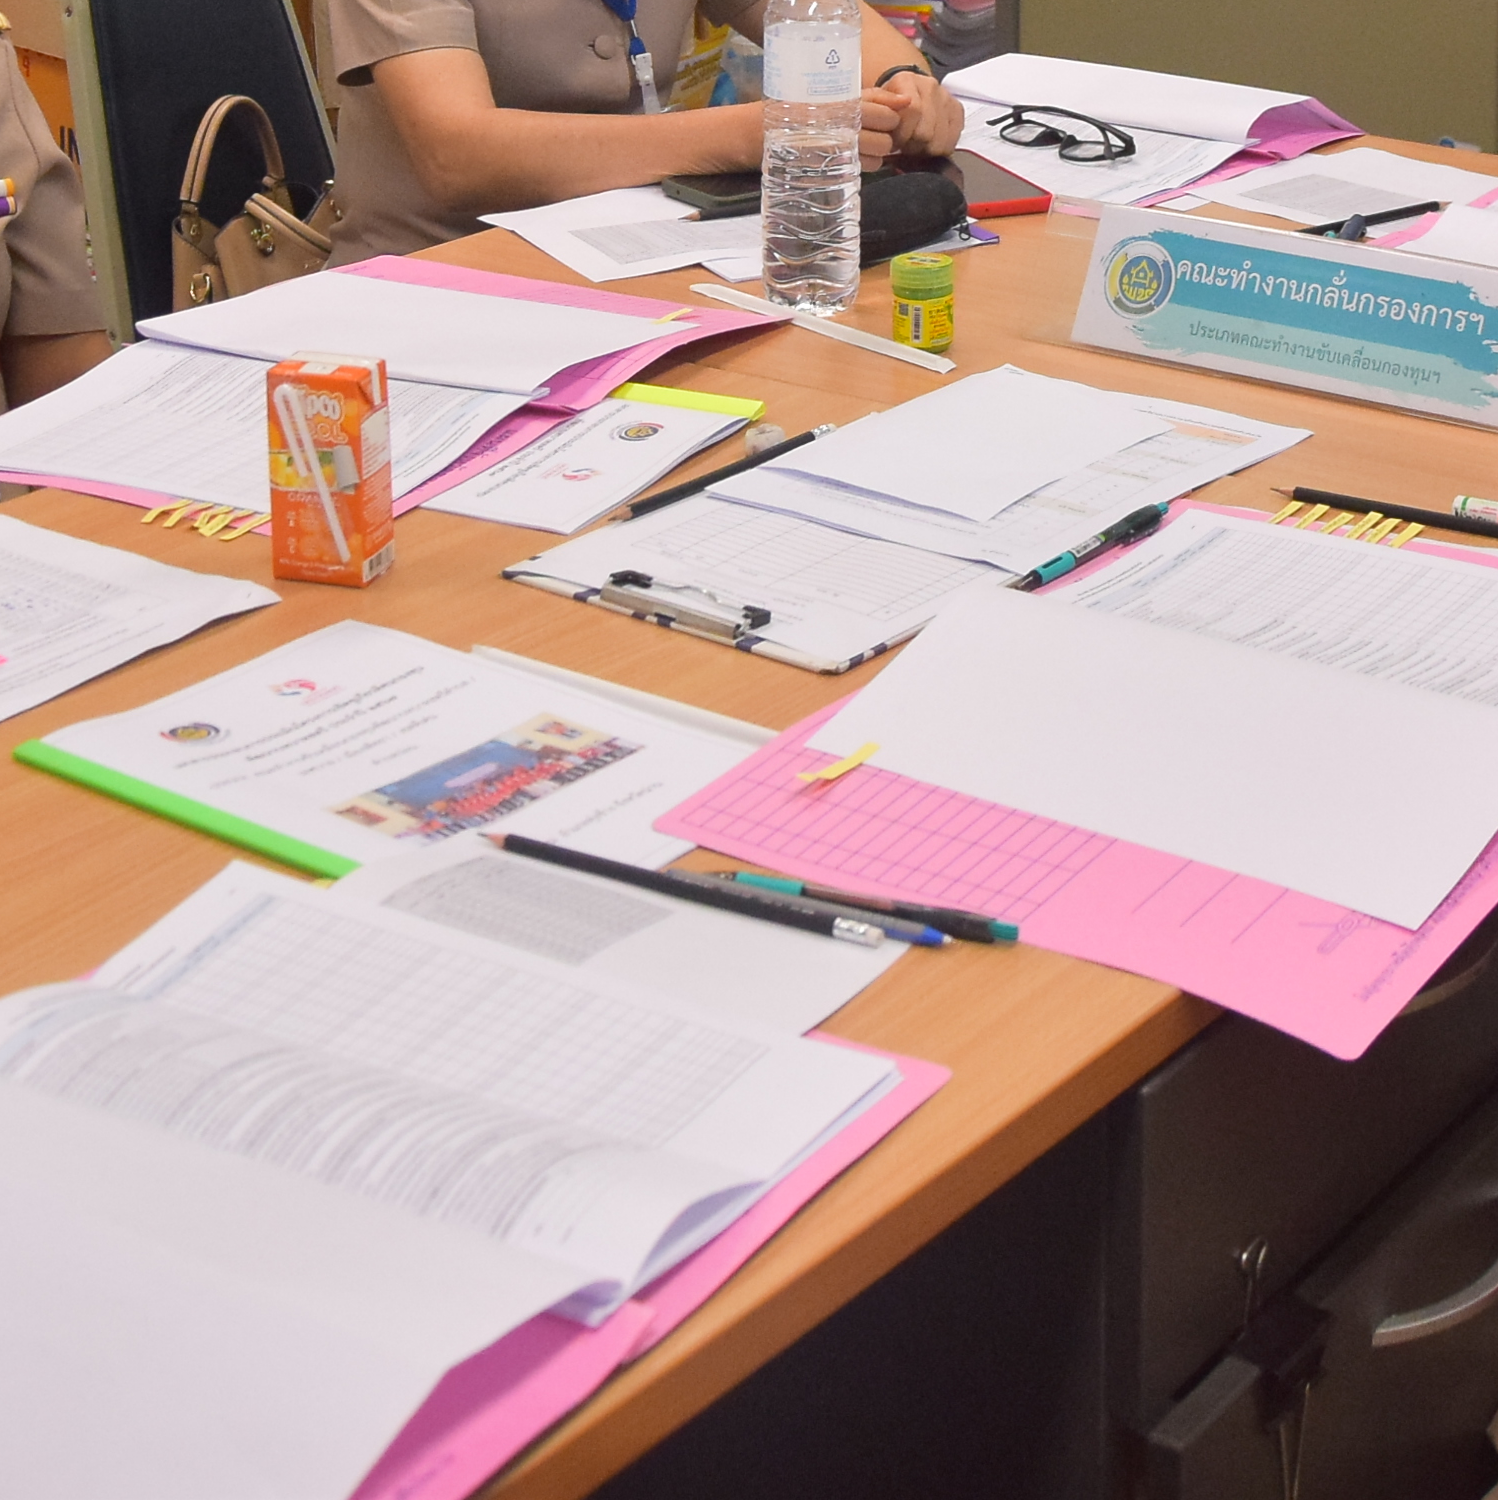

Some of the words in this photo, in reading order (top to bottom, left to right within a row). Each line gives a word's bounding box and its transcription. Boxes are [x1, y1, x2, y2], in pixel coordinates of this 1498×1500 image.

[1176, 259, 1485, 336] คณะทำงานกลั่นกรองการฯ
[1189, 321, 1441, 386] ประเภทคณะทำงานขับเคลื่อนกองทุนฯ
